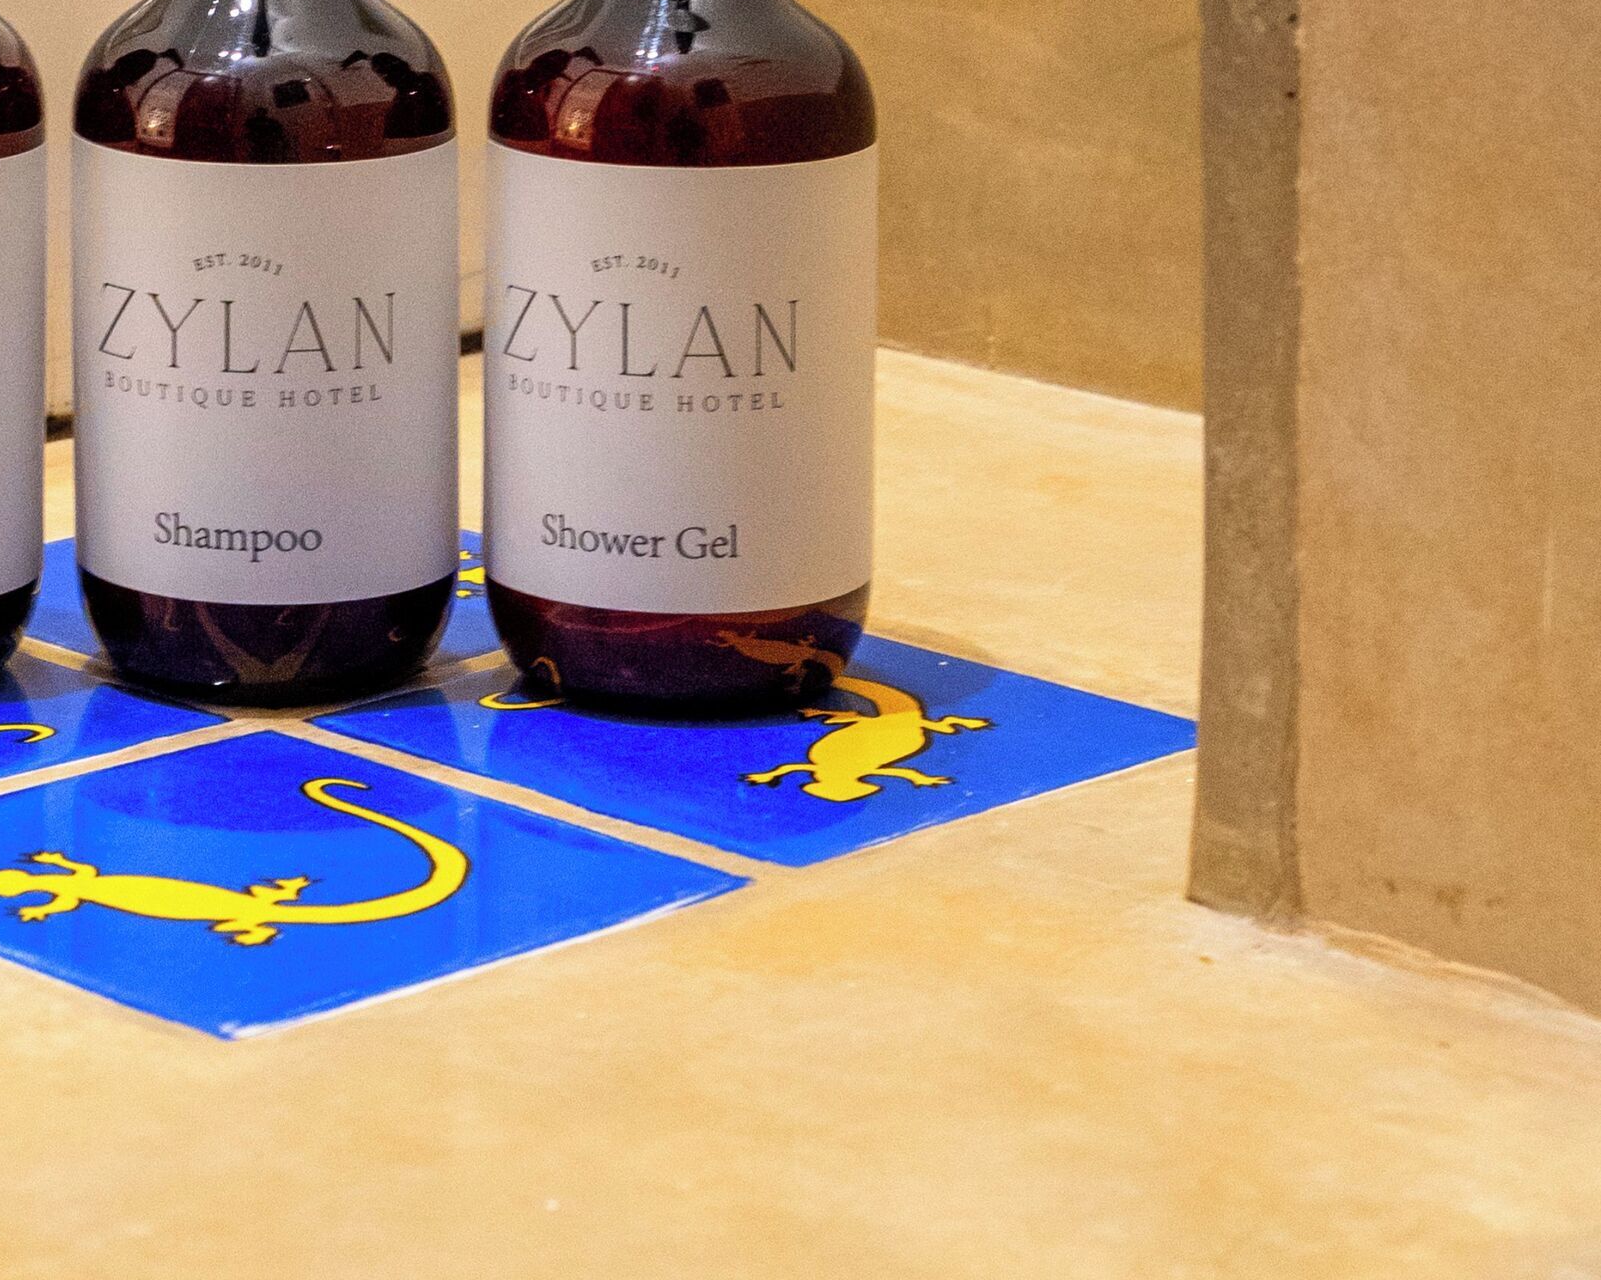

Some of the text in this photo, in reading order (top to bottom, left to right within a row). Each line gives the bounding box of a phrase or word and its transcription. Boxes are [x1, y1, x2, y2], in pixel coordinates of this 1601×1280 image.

[193, 253, 283, 276] EST. 2011
[591, 255, 680, 279] EST. 2011
[99, 283, 395, 374] ZYLAN
[503, 285, 799, 378] ZYLAN
[104, 371, 382, 410] BOUTIQUE HOTEL
[508, 374, 784, 412] BOUTIQUE HOTEL
[153, 512, 323, 563] Shampoo
[541, 513, 740, 560] Shower Gel
